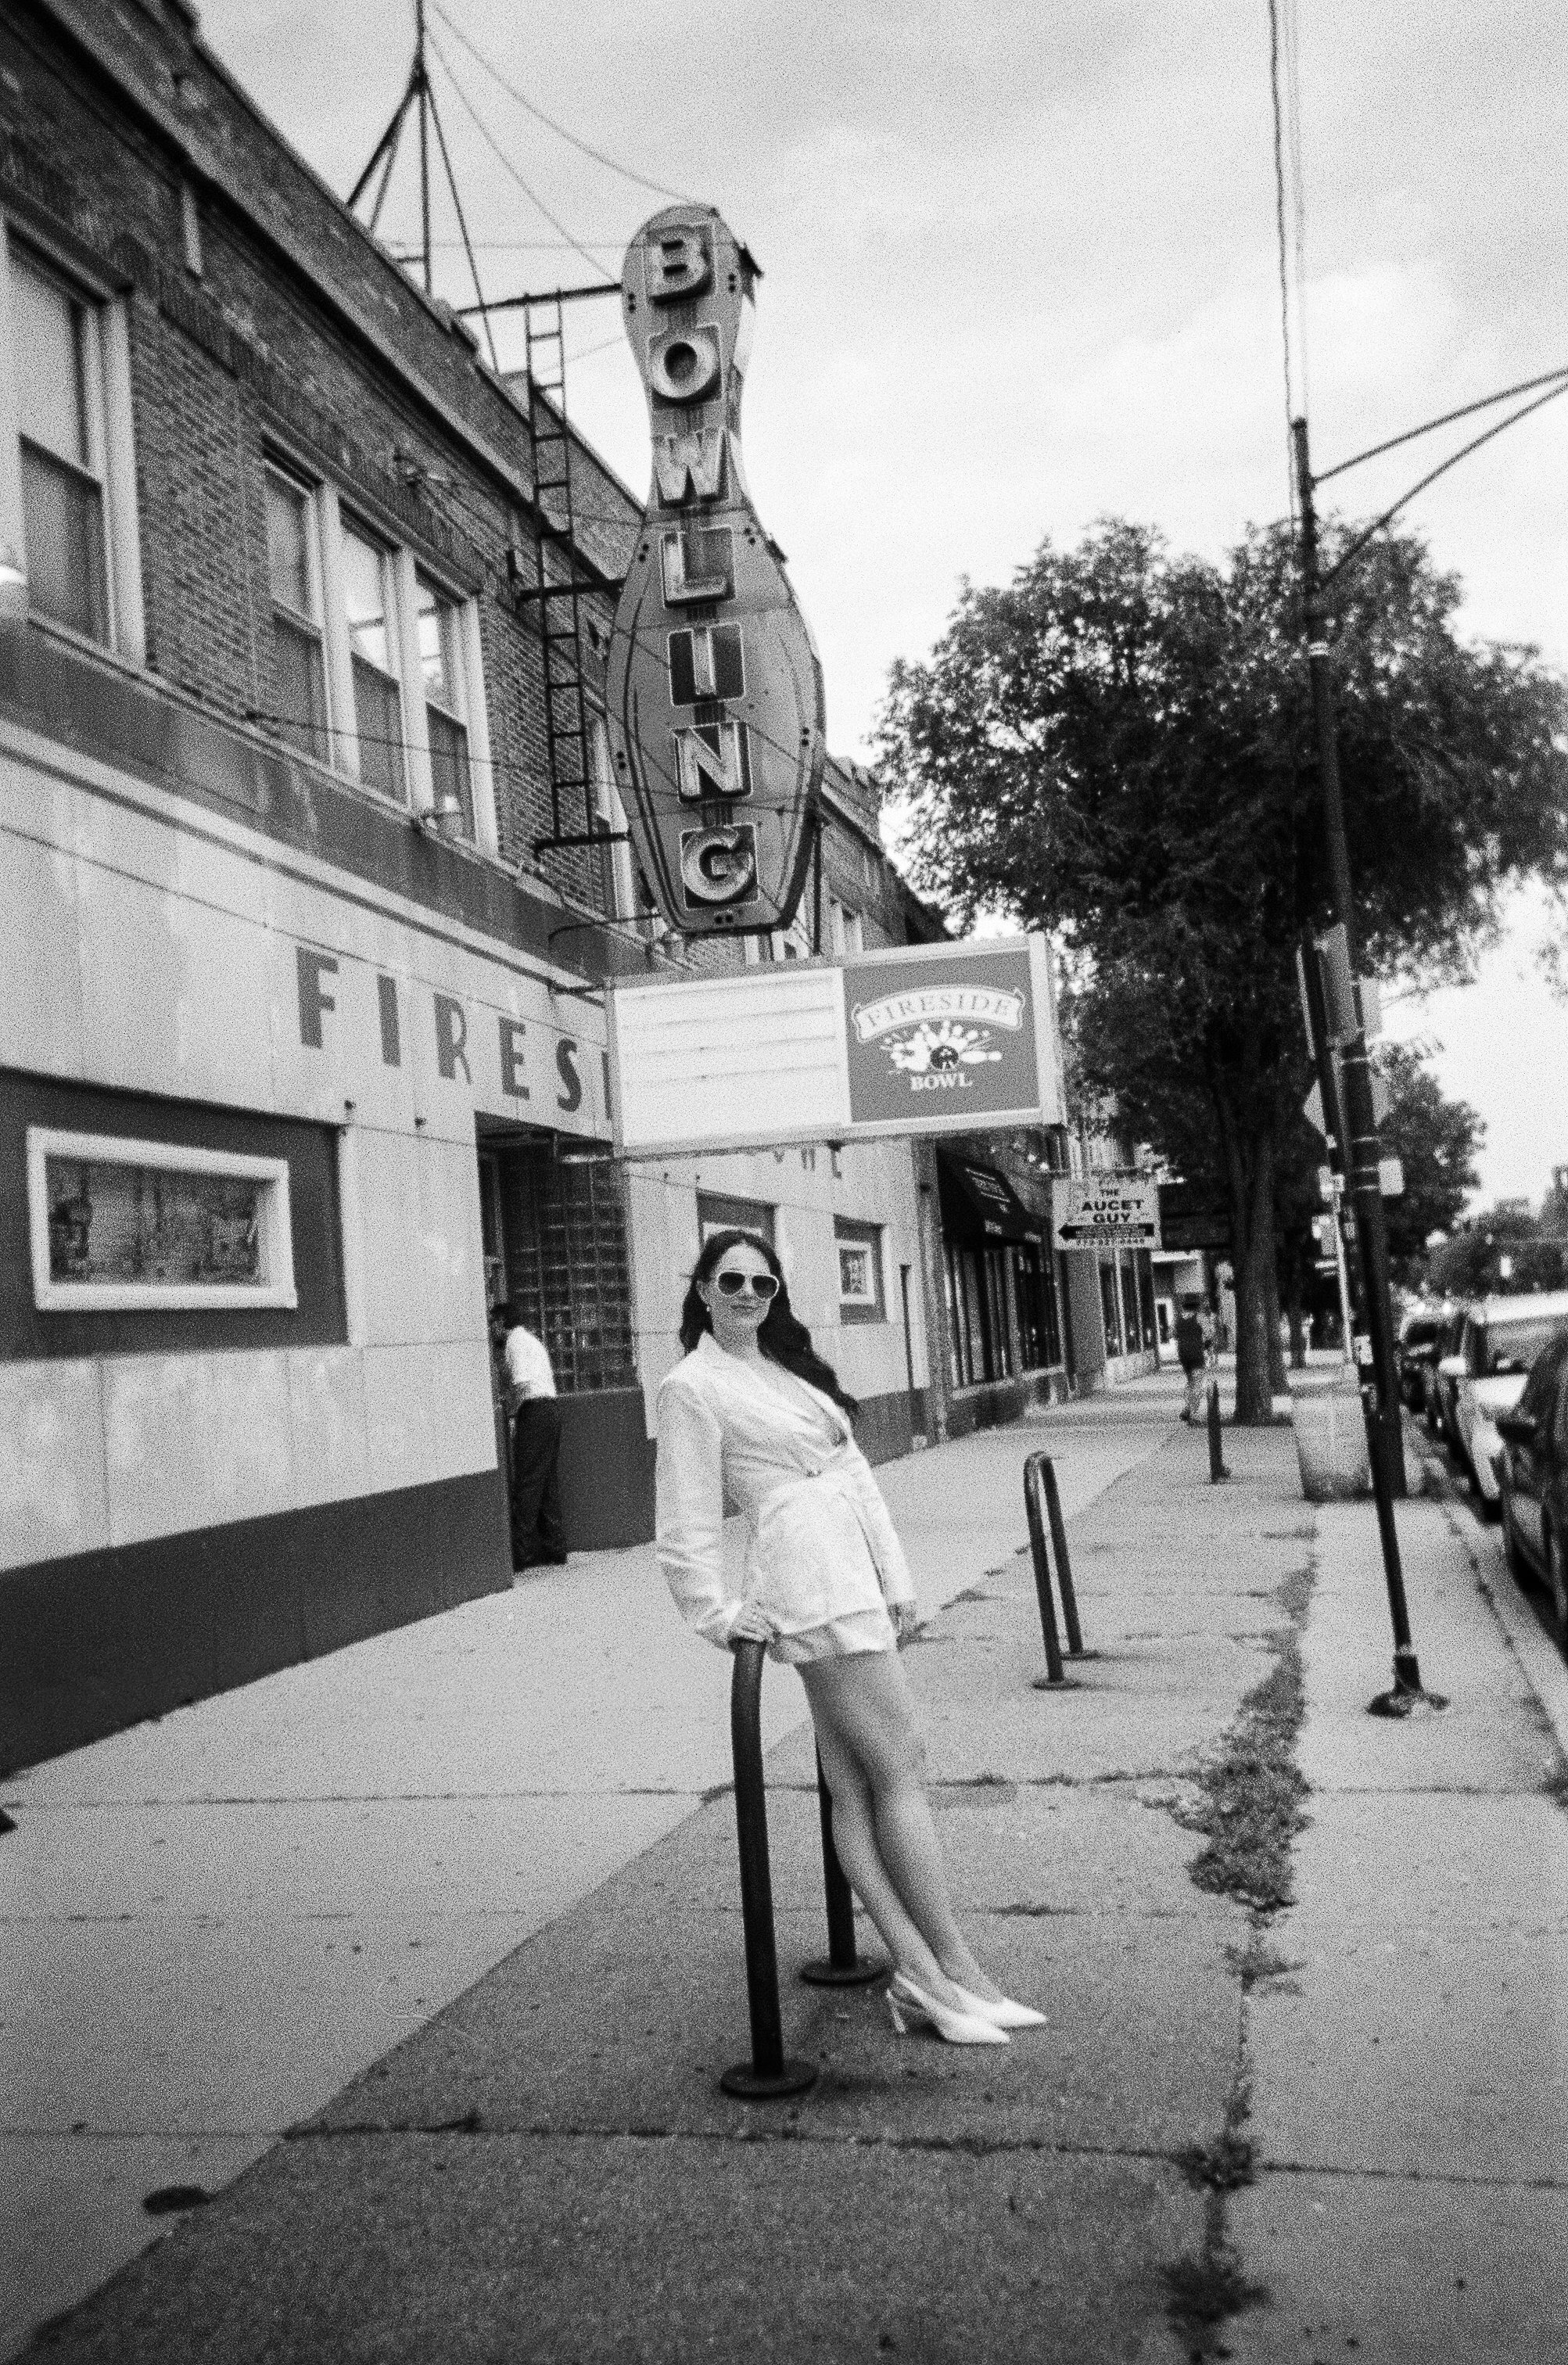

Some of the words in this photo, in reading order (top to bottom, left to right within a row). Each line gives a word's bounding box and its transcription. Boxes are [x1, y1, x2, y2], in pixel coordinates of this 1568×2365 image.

[648, 224, 756, 904] BOWLING
[867, 993, 1014, 1027] FIRESIDE
[295, 946, 612, 1120] FIRESI
[910, 1071, 974, 1091] BOWL
[1100, 1188, 1119, 1197] THE
[1093, 1212, 1131, 1224] GUY
